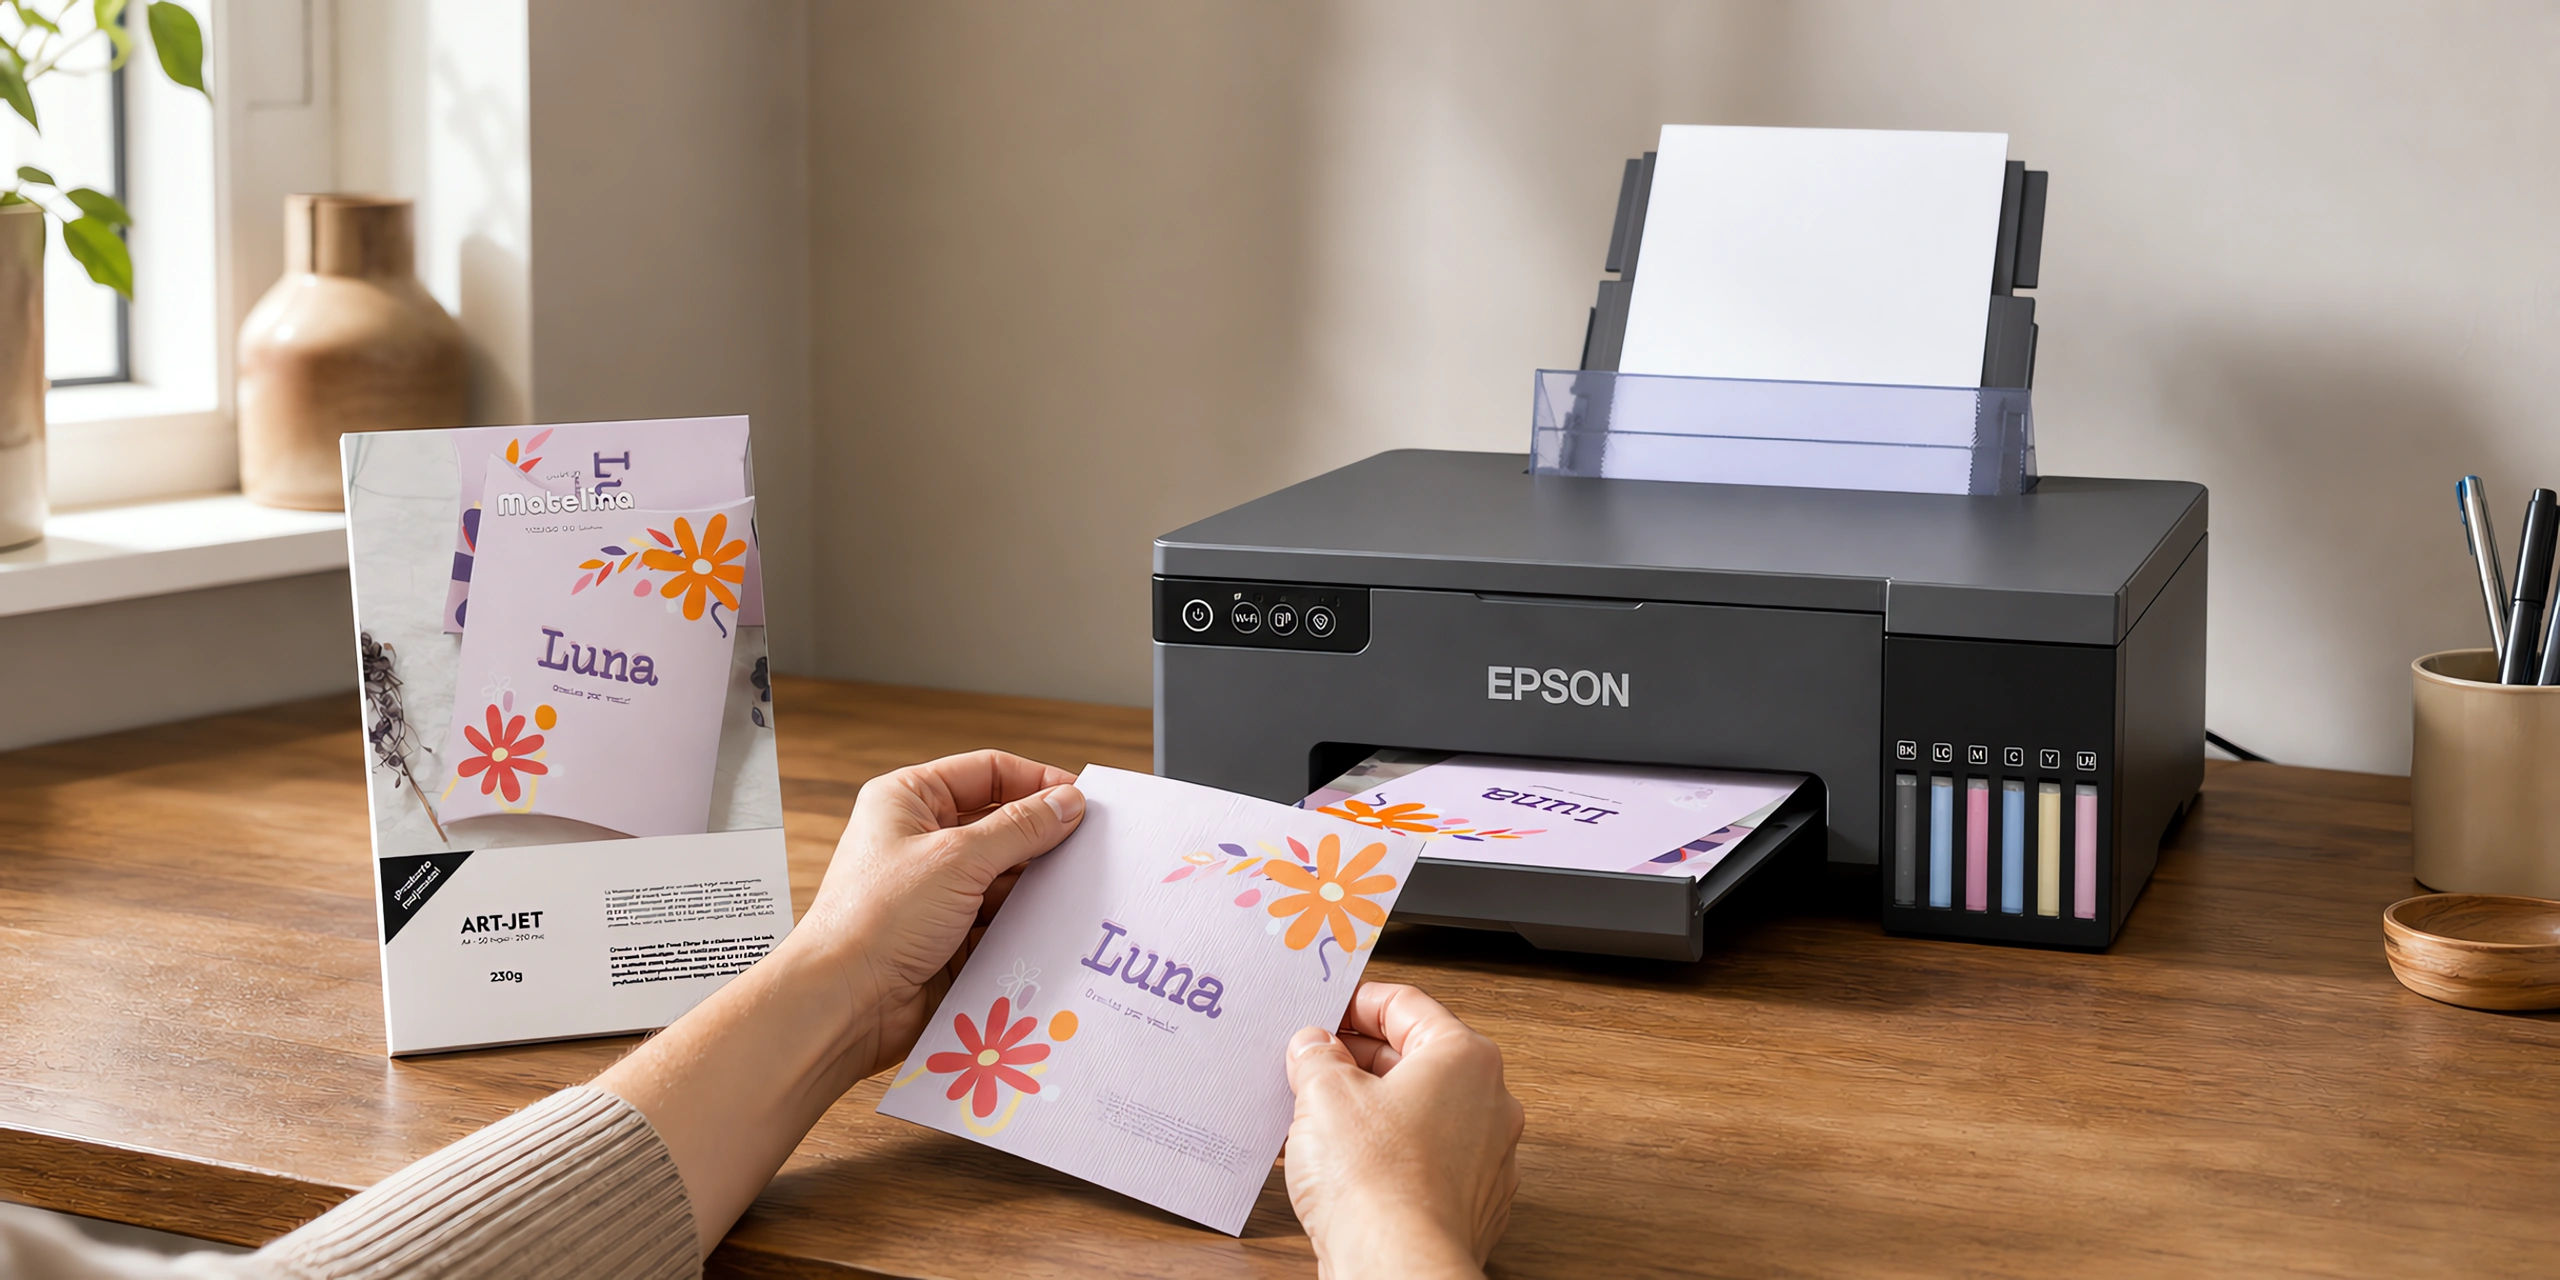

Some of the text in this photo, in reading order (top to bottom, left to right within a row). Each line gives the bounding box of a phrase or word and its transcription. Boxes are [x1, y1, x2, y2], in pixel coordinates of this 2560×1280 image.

[497, 487, 635, 516] Matelina
[537, 627, 659, 686] Luna
[1488, 665, 1629, 707] EPSON
[1899, 745, 1914, 756] BK
[1936, 747, 1950, 758] LC
[1972, 750, 1983, 760] M
[2009, 751, 2019, 762] C
[2045, 753, 2055, 764] Y
[1482, 787, 1619, 824] Luna
[461, 911, 543, 934] ART-JET
[1081, 921, 1225, 1019] Luna
